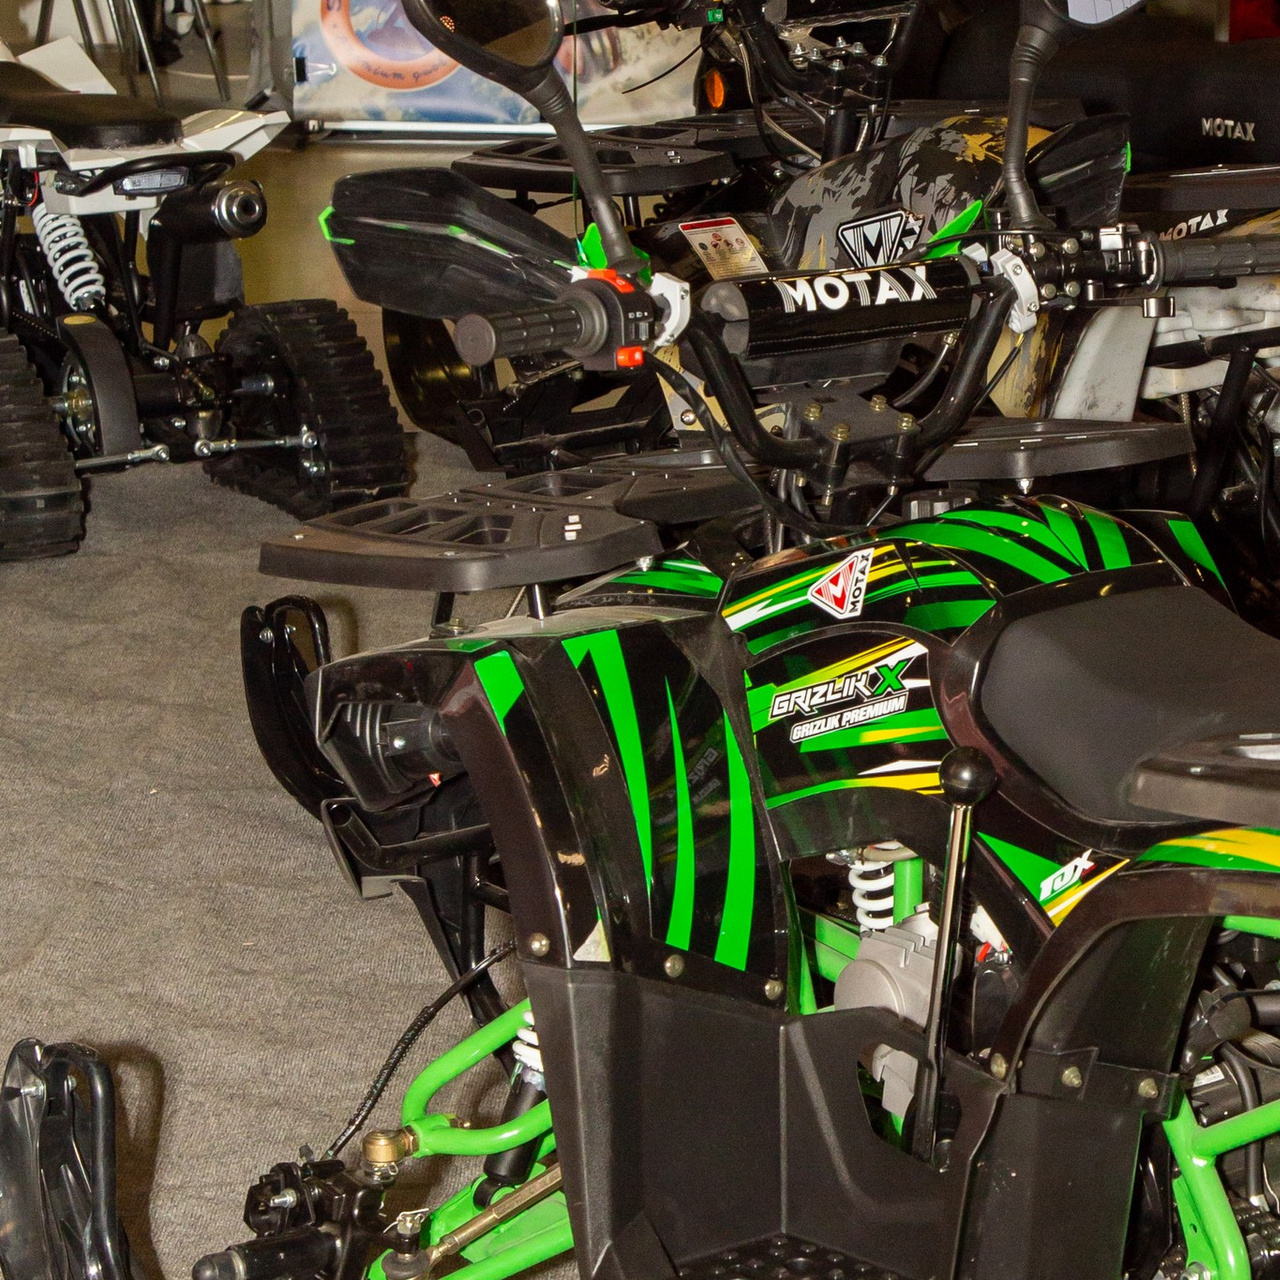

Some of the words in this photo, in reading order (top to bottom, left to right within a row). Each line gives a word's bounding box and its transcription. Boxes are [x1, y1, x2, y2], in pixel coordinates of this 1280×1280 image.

[1201, 117, 1256, 142] MOTAX
[774, 266, 938, 314] MOTAX
[849, 552, 871, 614] MOTAX
[792, 714, 844, 741] GRIZLIK
[843, 695, 907, 727] PREMIUM
